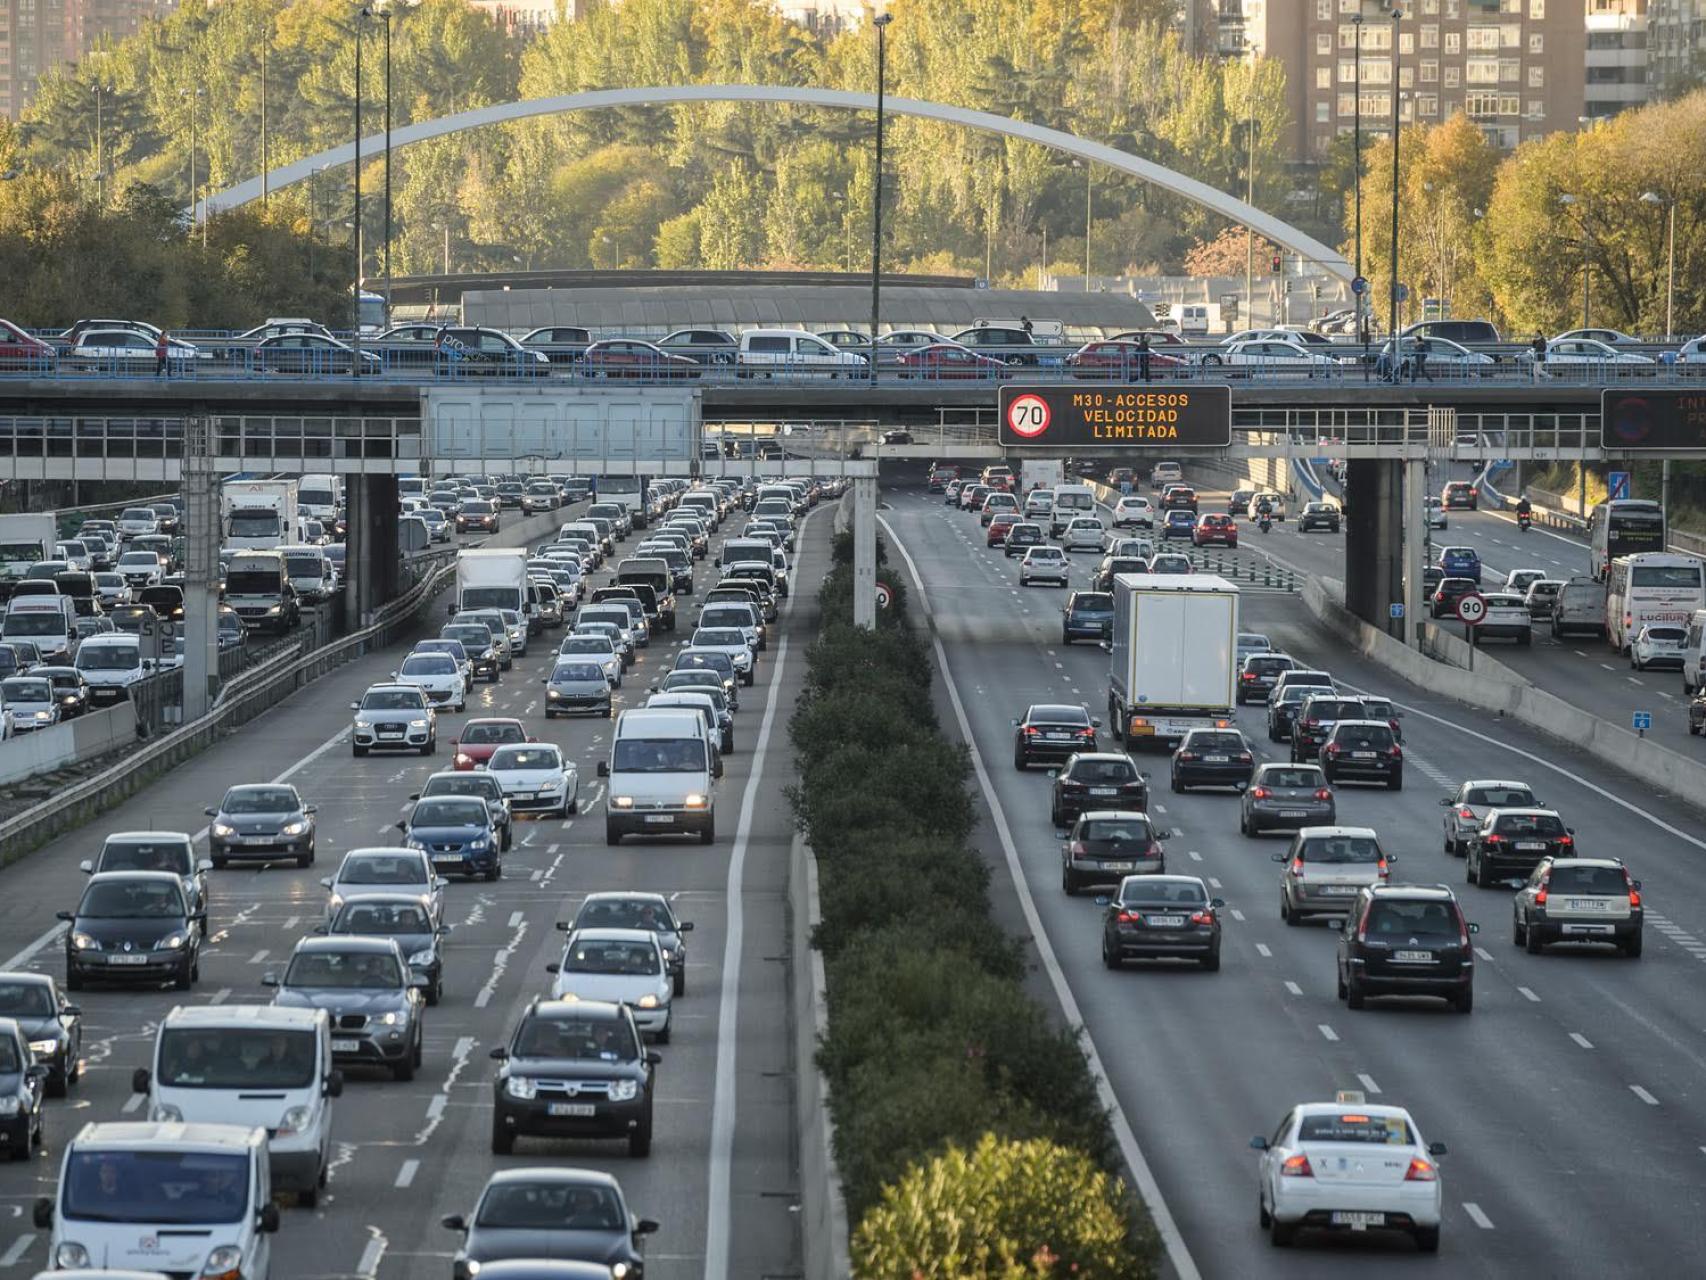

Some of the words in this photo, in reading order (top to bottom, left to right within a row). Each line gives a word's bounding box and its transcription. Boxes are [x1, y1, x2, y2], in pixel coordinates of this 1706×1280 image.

[1073, 394, 1189, 407] M30-ACCESOS
[1016, 406, 1043, 425] 70
[1084, 410, 1178, 423] VELOCIDAD
[1094, 426, 1178, 438] LIMITADA
[1462, 602, 1481, 613] 90
